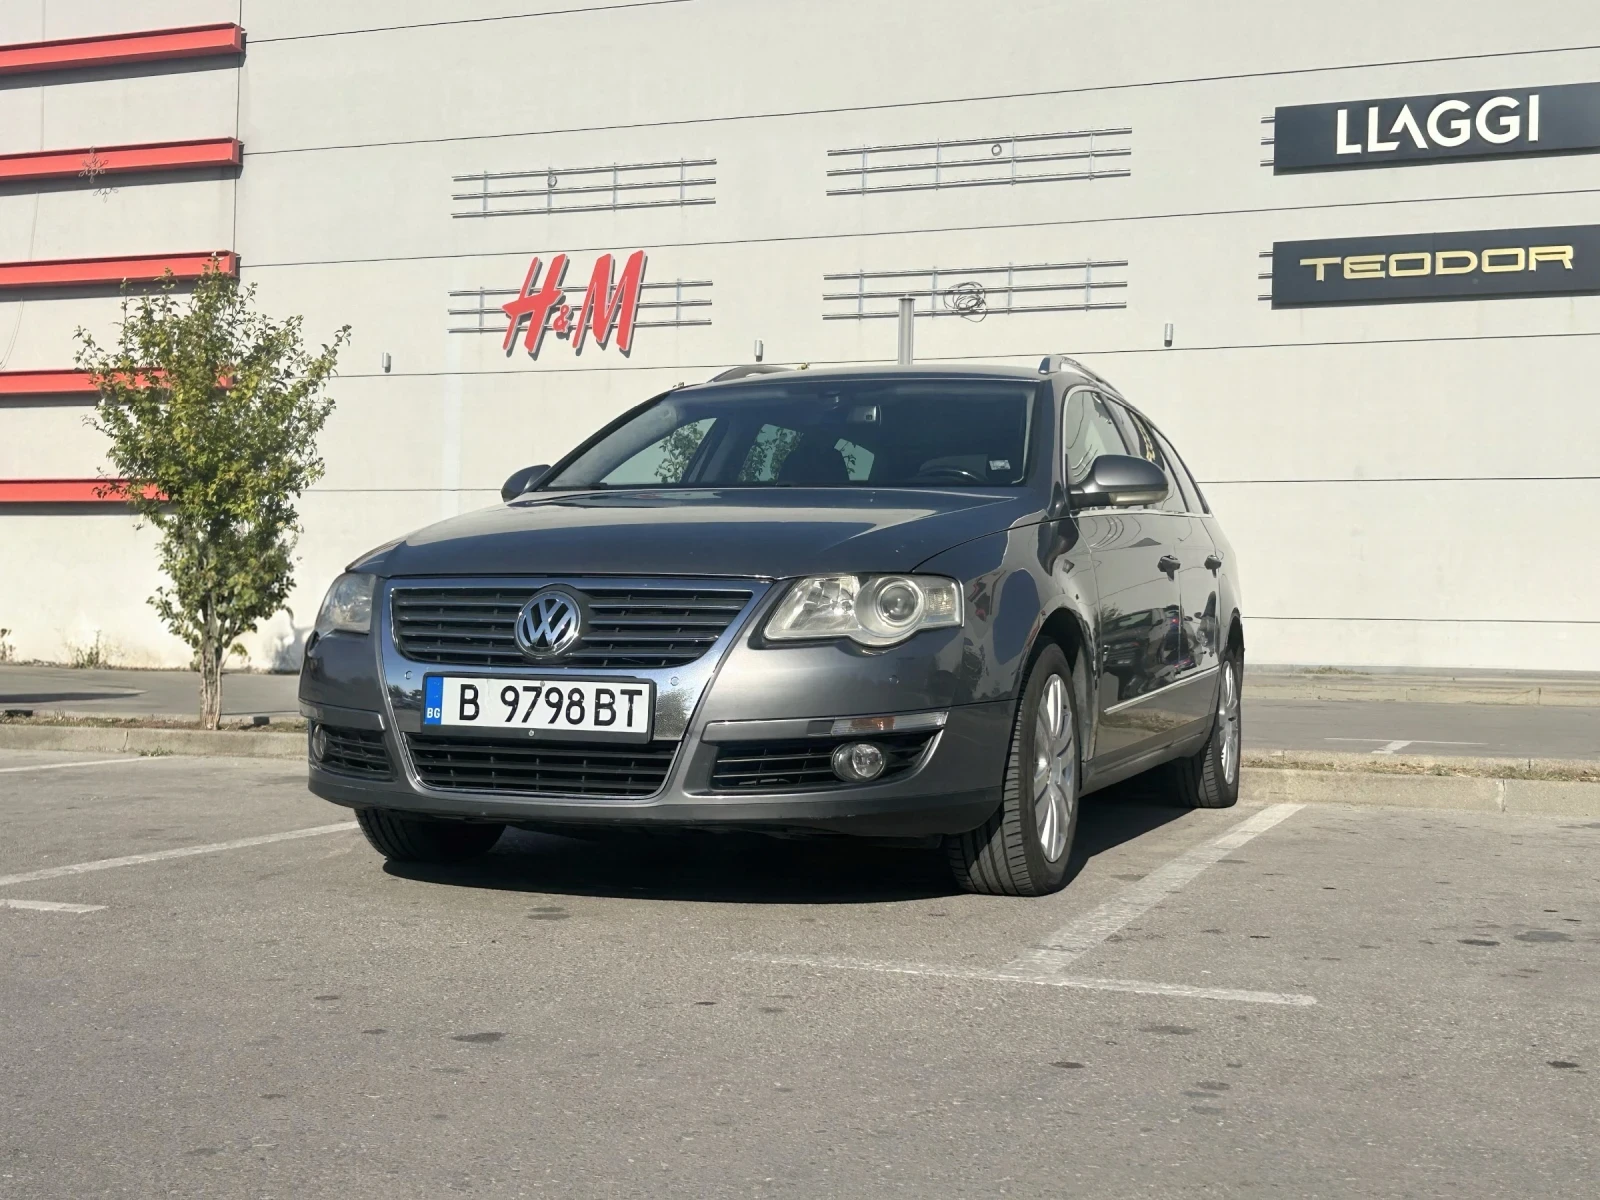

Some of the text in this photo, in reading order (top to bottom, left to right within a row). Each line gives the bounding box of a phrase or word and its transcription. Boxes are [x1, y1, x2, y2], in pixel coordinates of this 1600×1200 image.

[1336, 94, 1539, 154] LLAGGI
[1299, 245, 1574, 281] TEODOR
[501, 249, 645, 353] H&M
[519, 593, 578, 653] VW
[426, 707, 441, 719] BG
[458, 683, 643, 728] B 9798 BT
